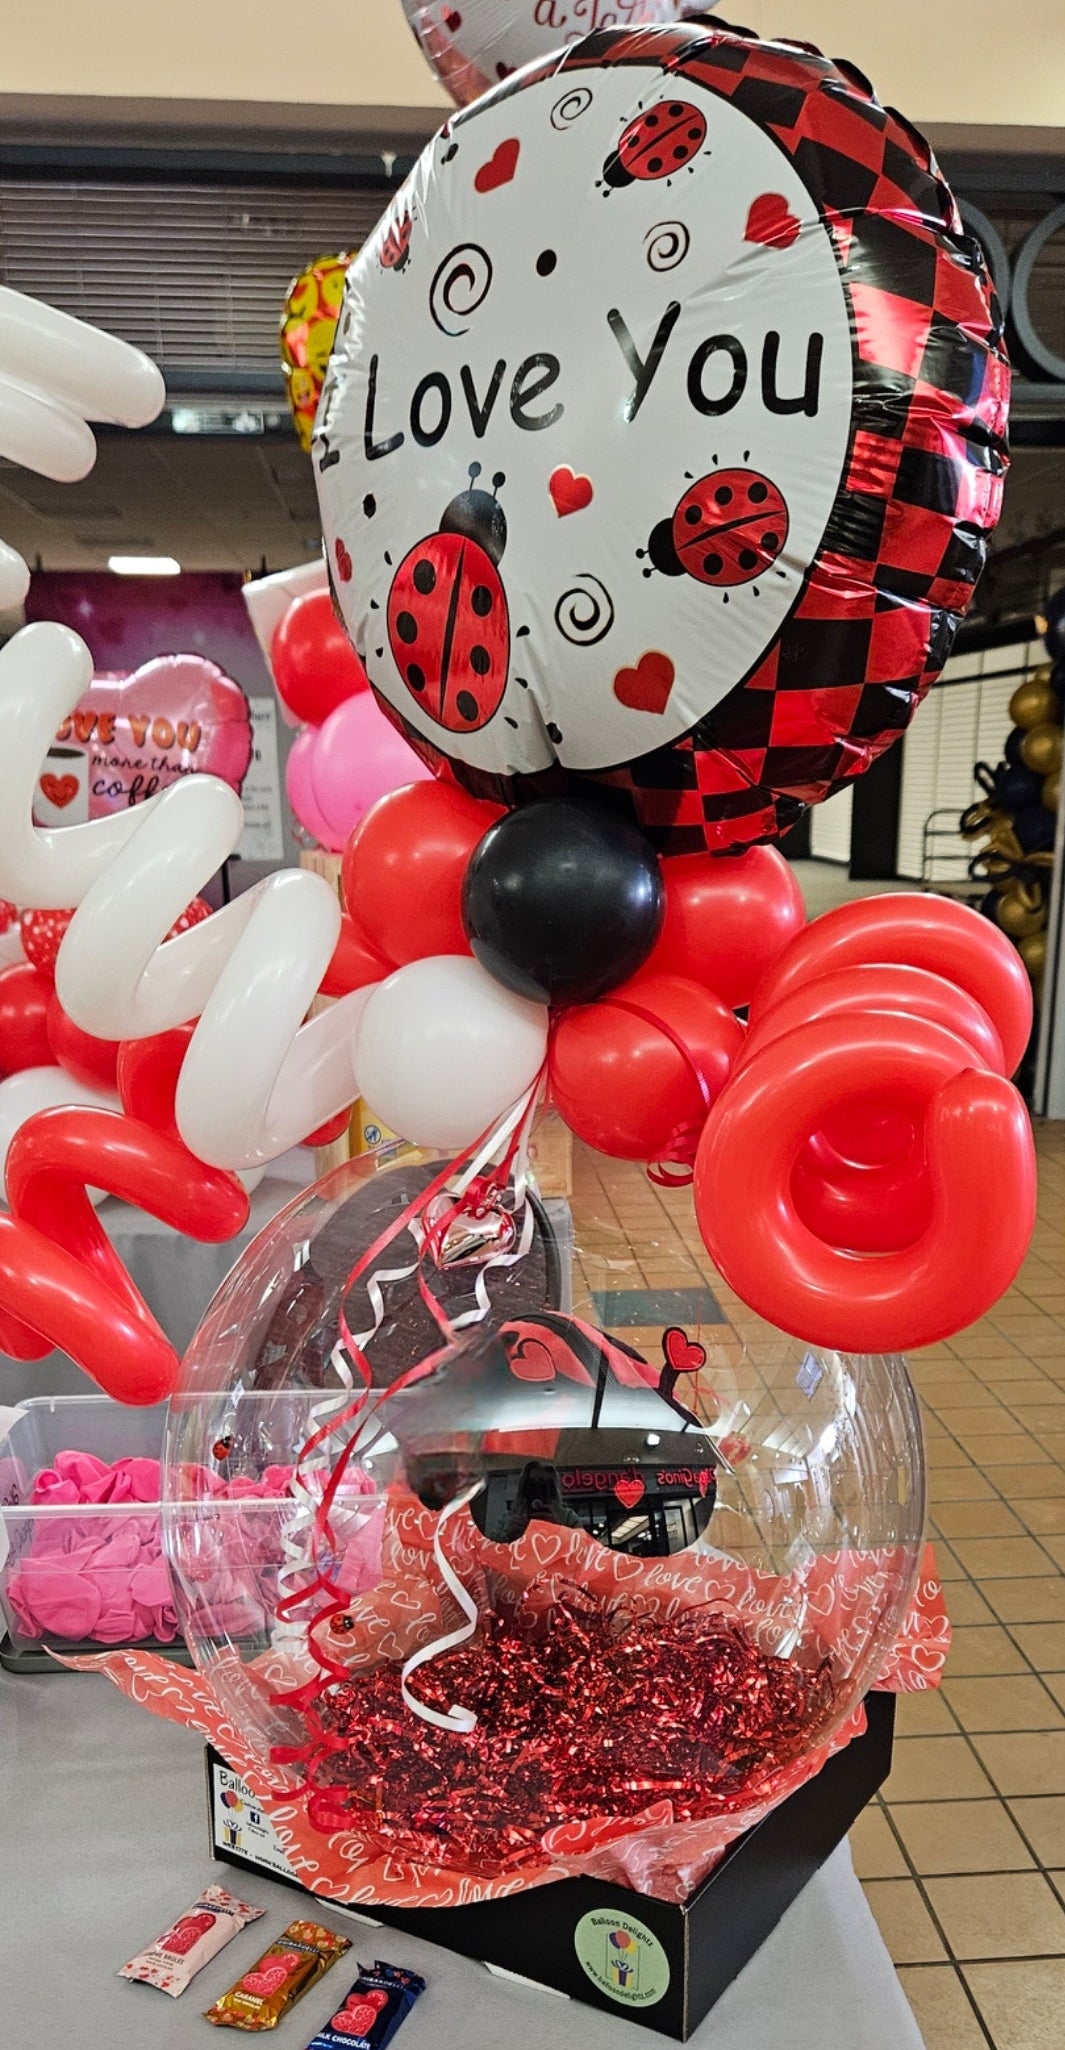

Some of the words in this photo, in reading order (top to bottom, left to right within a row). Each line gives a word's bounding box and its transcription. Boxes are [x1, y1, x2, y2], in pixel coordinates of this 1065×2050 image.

[363, 353, 565, 461] Love
[606, 301, 825, 423] You
[128, 714, 202, 753] YOU
[91, 754, 147, 771] more
[92, 775, 169, 807] coff
[643, 1563, 702, 1594] love
[736, 1587, 796, 1619] love
[219, 1770, 256, 1799] Balloo
[590, 1917, 621, 1926] Balloon
[331, 2035, 371, 2050] CHOCOLATE
